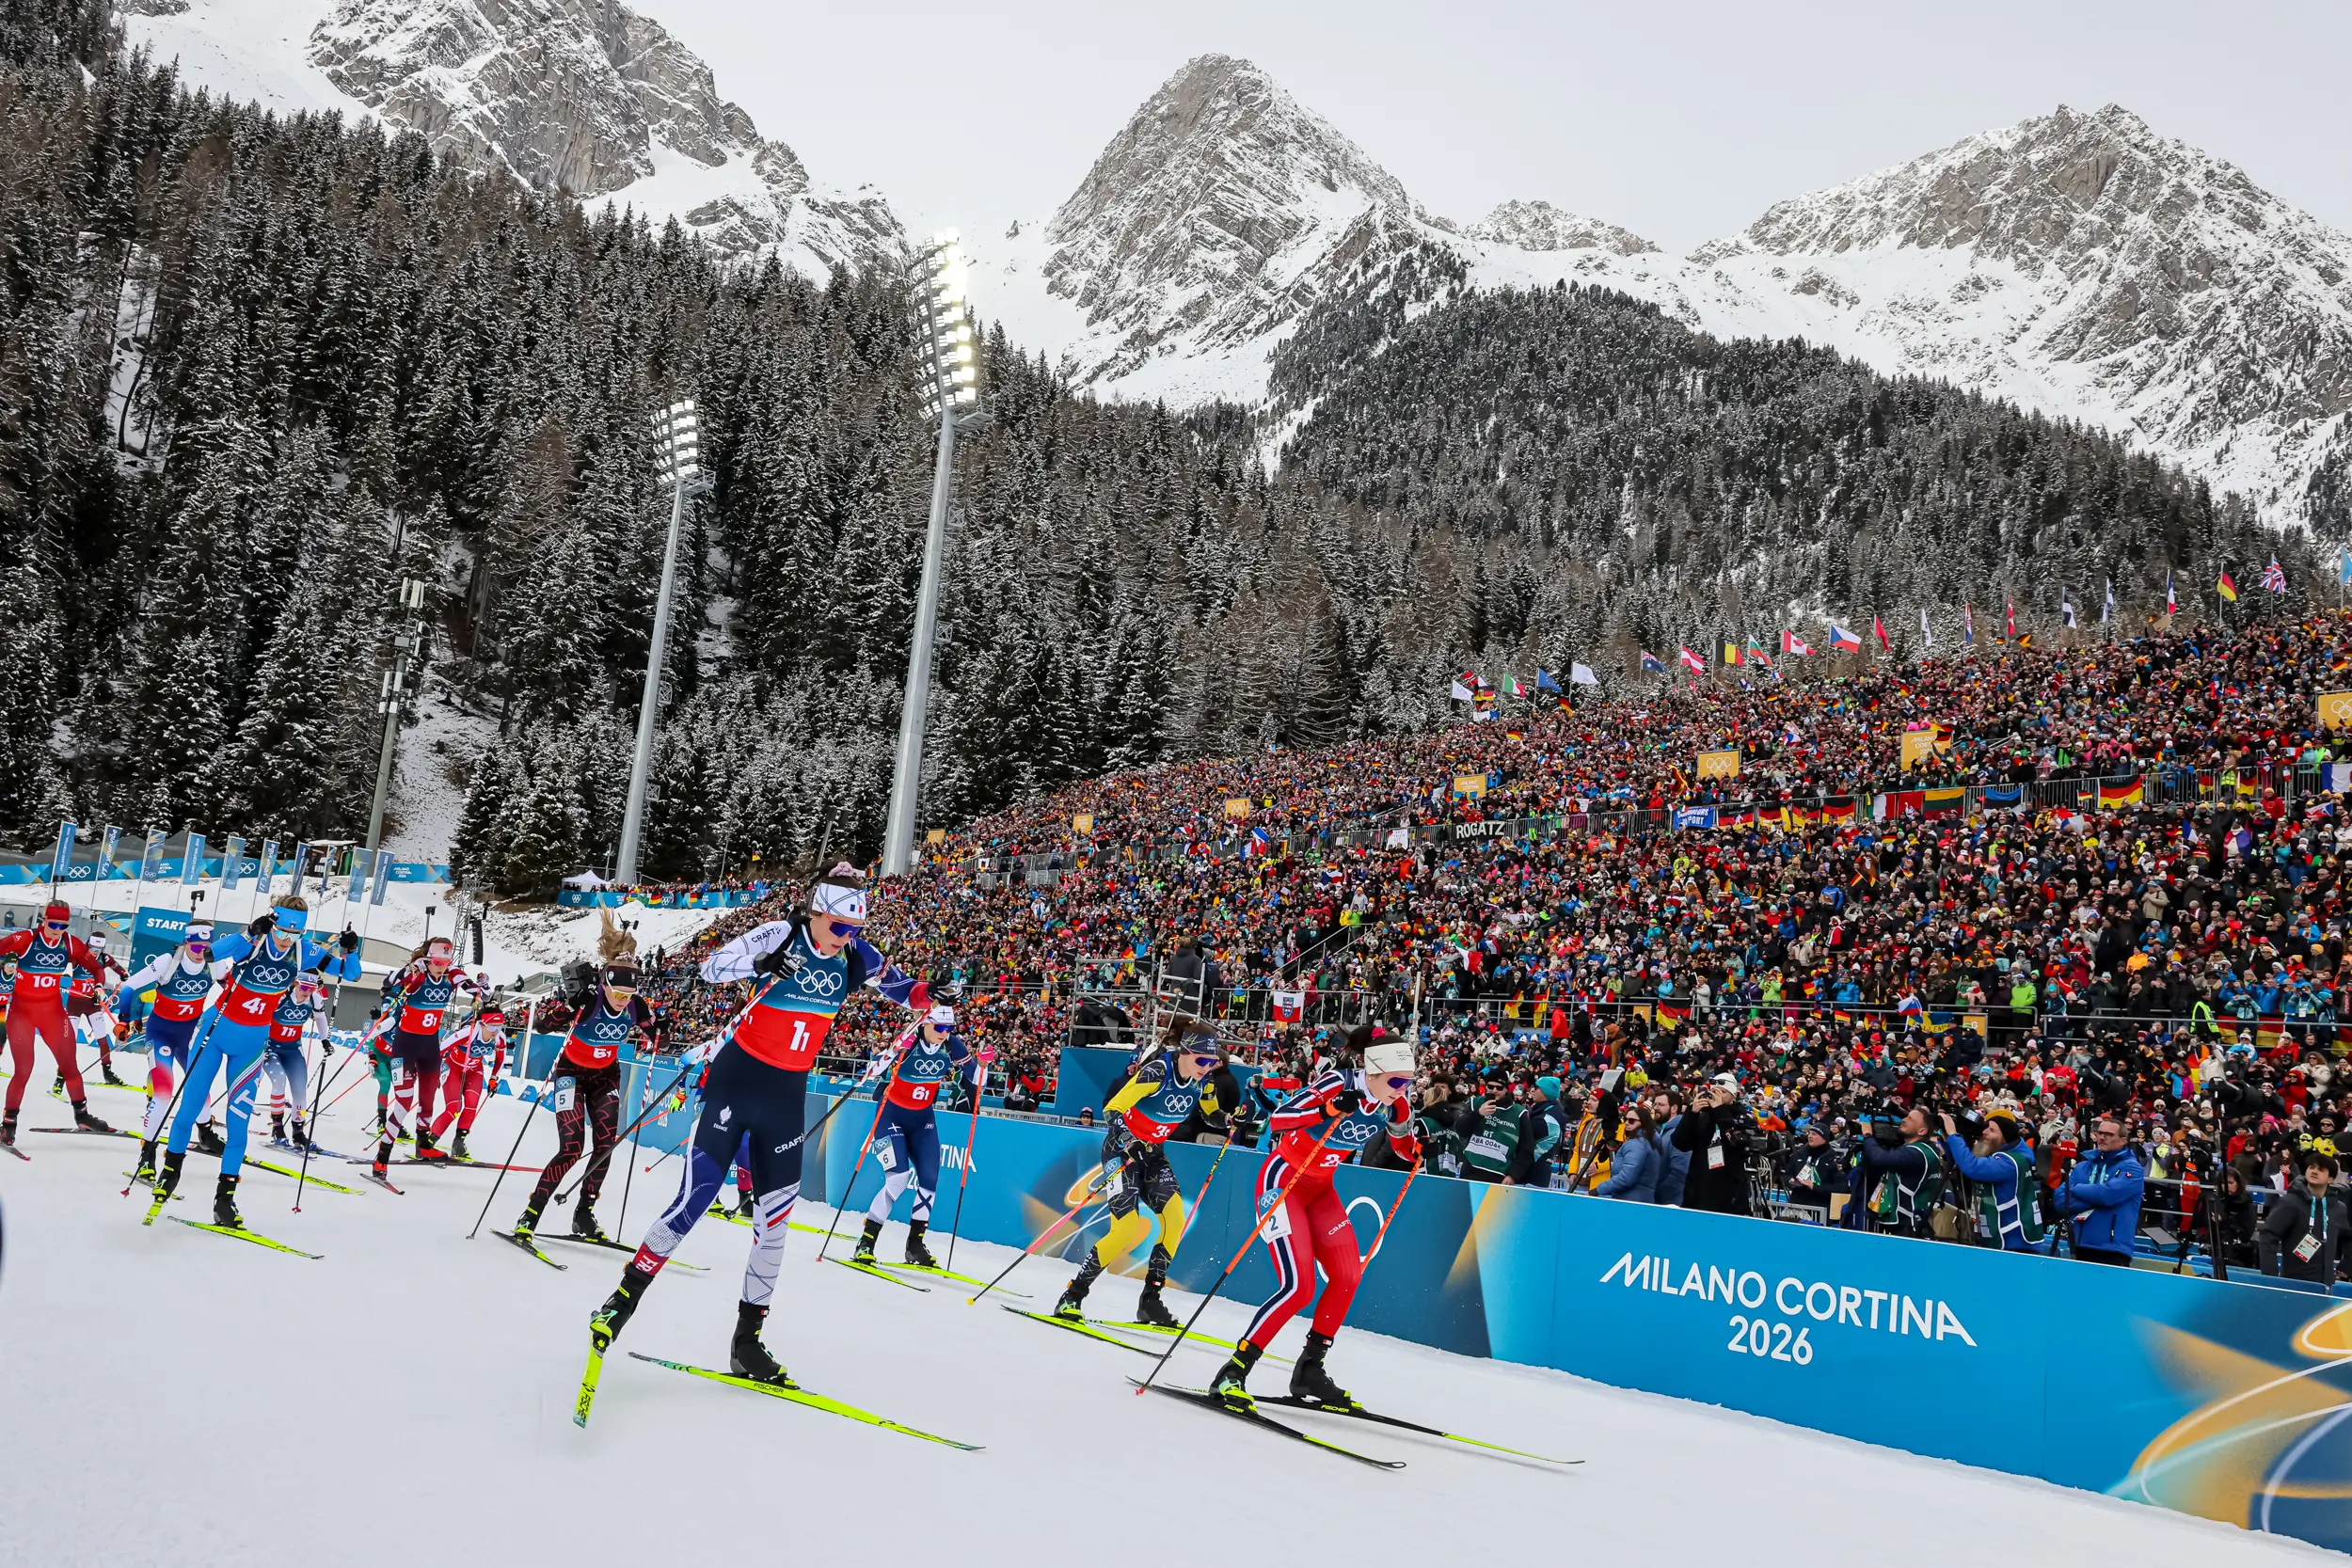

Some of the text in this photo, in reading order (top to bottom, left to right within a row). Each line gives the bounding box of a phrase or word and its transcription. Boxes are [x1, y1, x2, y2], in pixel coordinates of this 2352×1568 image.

[109, 828, 118, 844] vibe
[1455, 820, 1505, 839] ROGATZ
[146, 917, 187, 931] START
[751, 927, 775, 943] CRAFT
[784, 992, 809, 1002] MILANO
[809, 997, 831, 1006] CORTINA
[559, 1094, 565, 1105] 5
[143, 1101, 156, 1128] CZE
[1483, 1130, 1494, 1138] RT
[773, 1136, 803, 1155] CRAFT
[882, 1153, 889, 1164] 6
[1268, 1214, 1279, 1232] 2
[1327, 1219, 1351, 1237] CRAFT
[635, 1255, 659, 1273] FR
[1599, 1252, 1978, 1347] MILANO CORTINA
[1727, 1315, 1813, 1365] 2026
[753, 1382, 785, 1395] FISCHER
[1224, 1403, 1245, 1414] FISCHER
[1321, 1404, 1350, 1414] FISCHER
